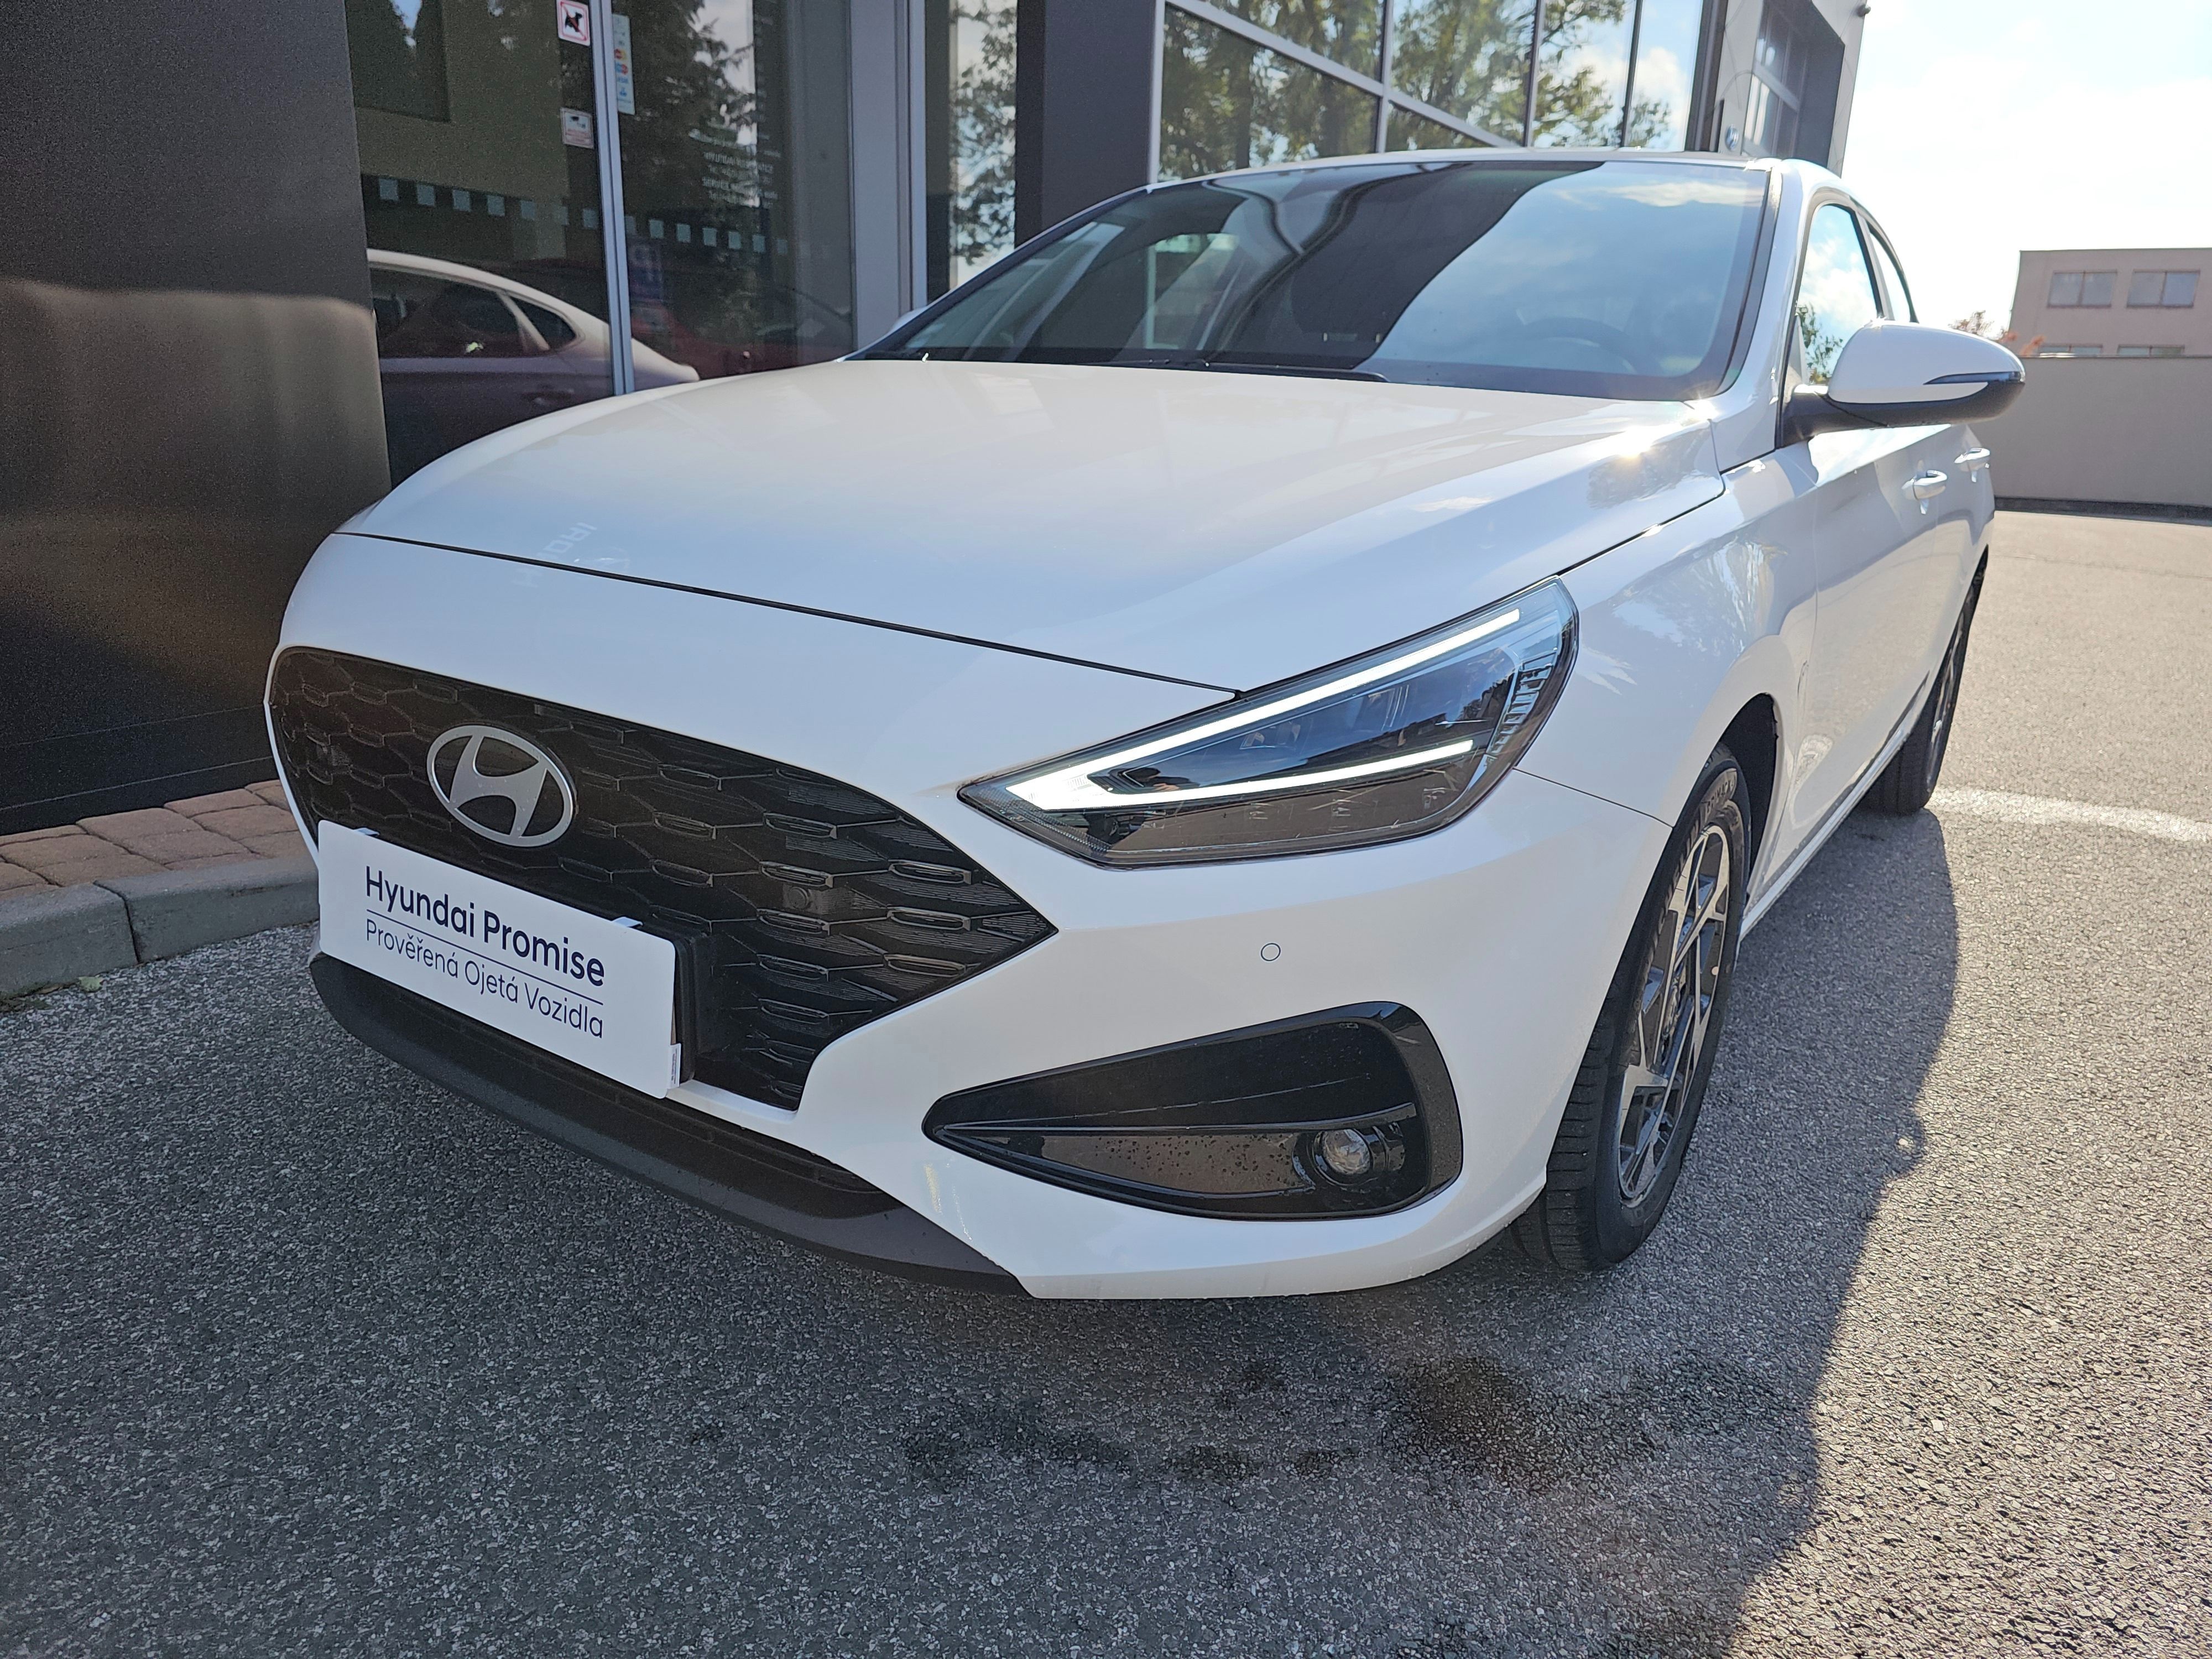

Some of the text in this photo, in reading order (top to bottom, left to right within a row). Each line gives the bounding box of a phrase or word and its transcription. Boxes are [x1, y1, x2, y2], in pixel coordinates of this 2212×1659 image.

[366, 865, 604, 987] Hyundai Promise
[366, 918, 603, 1039] Prověřená Ojetá Vozidla
